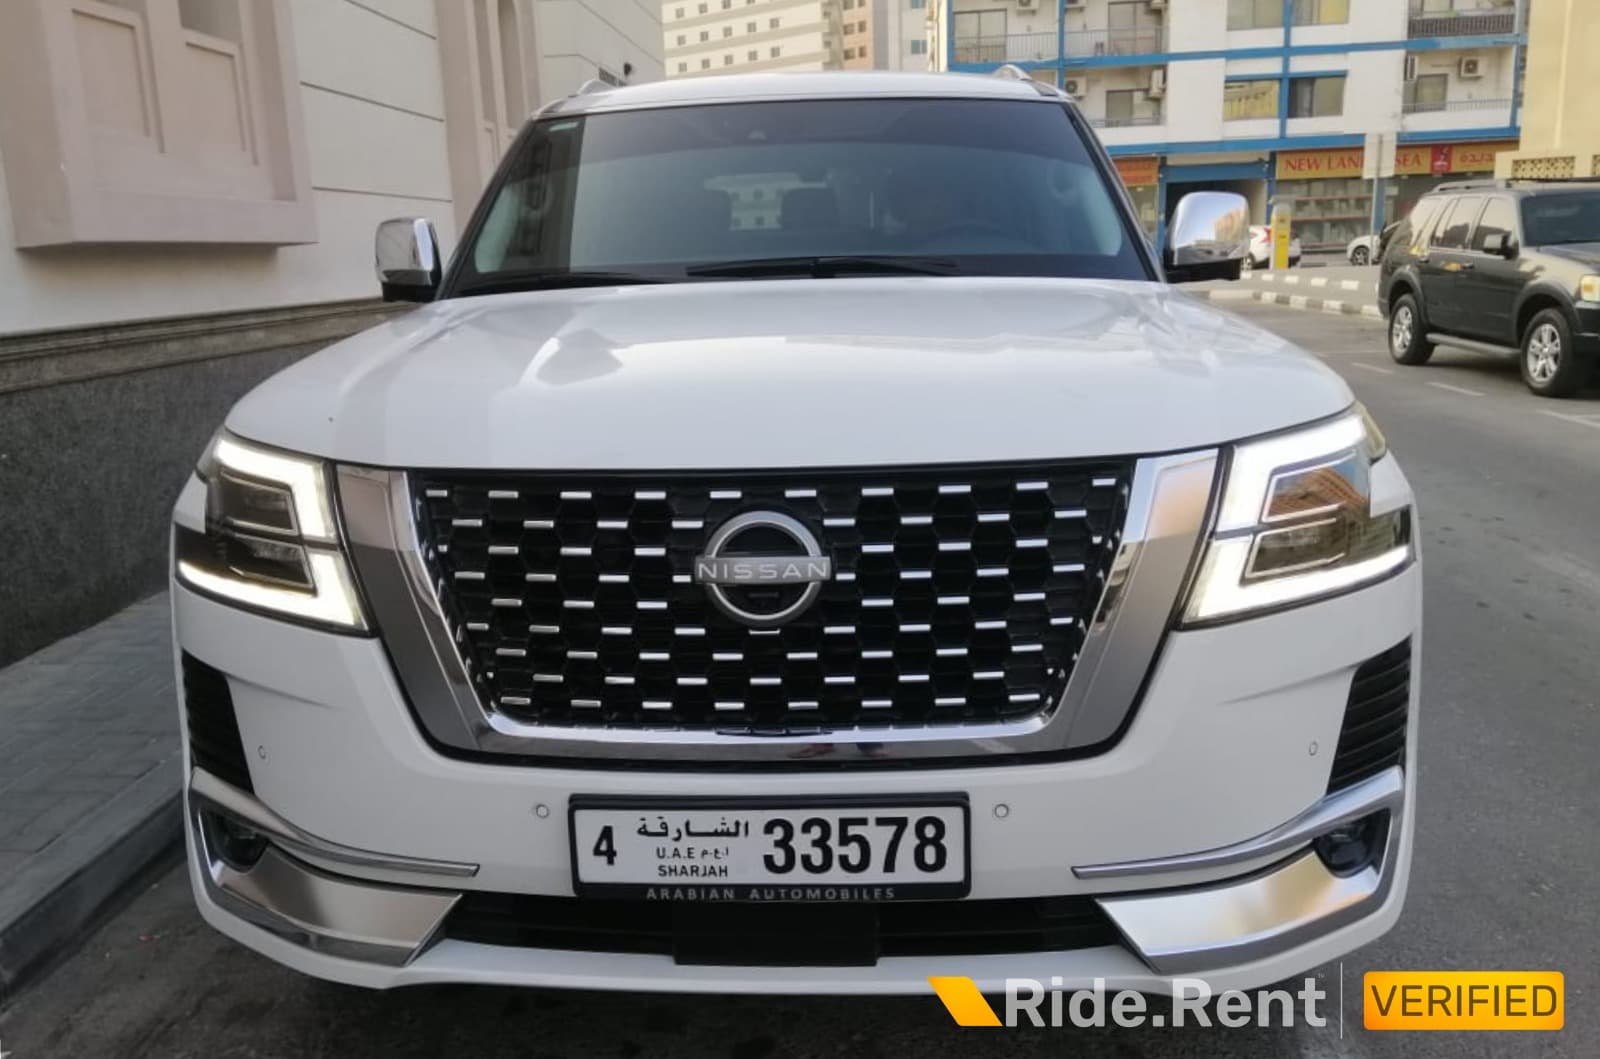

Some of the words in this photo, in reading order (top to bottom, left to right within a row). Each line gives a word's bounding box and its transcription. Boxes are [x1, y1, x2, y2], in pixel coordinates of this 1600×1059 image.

[1286, 157, 1321, 171] NEW
[1327, 154, 1364, 171] LAN
[697, 562, 829, 580] NISSAN
[637, 815, 750, 842] الشارقة
[592, 825, 618, 866] 4
[763, 815, 947, 875] 33578
[657, 864, 729, 878] SHARJAH
[646, 887, 736, 901] ARABIAN
[749, 886, 896, 901] AUTOMOBILES
